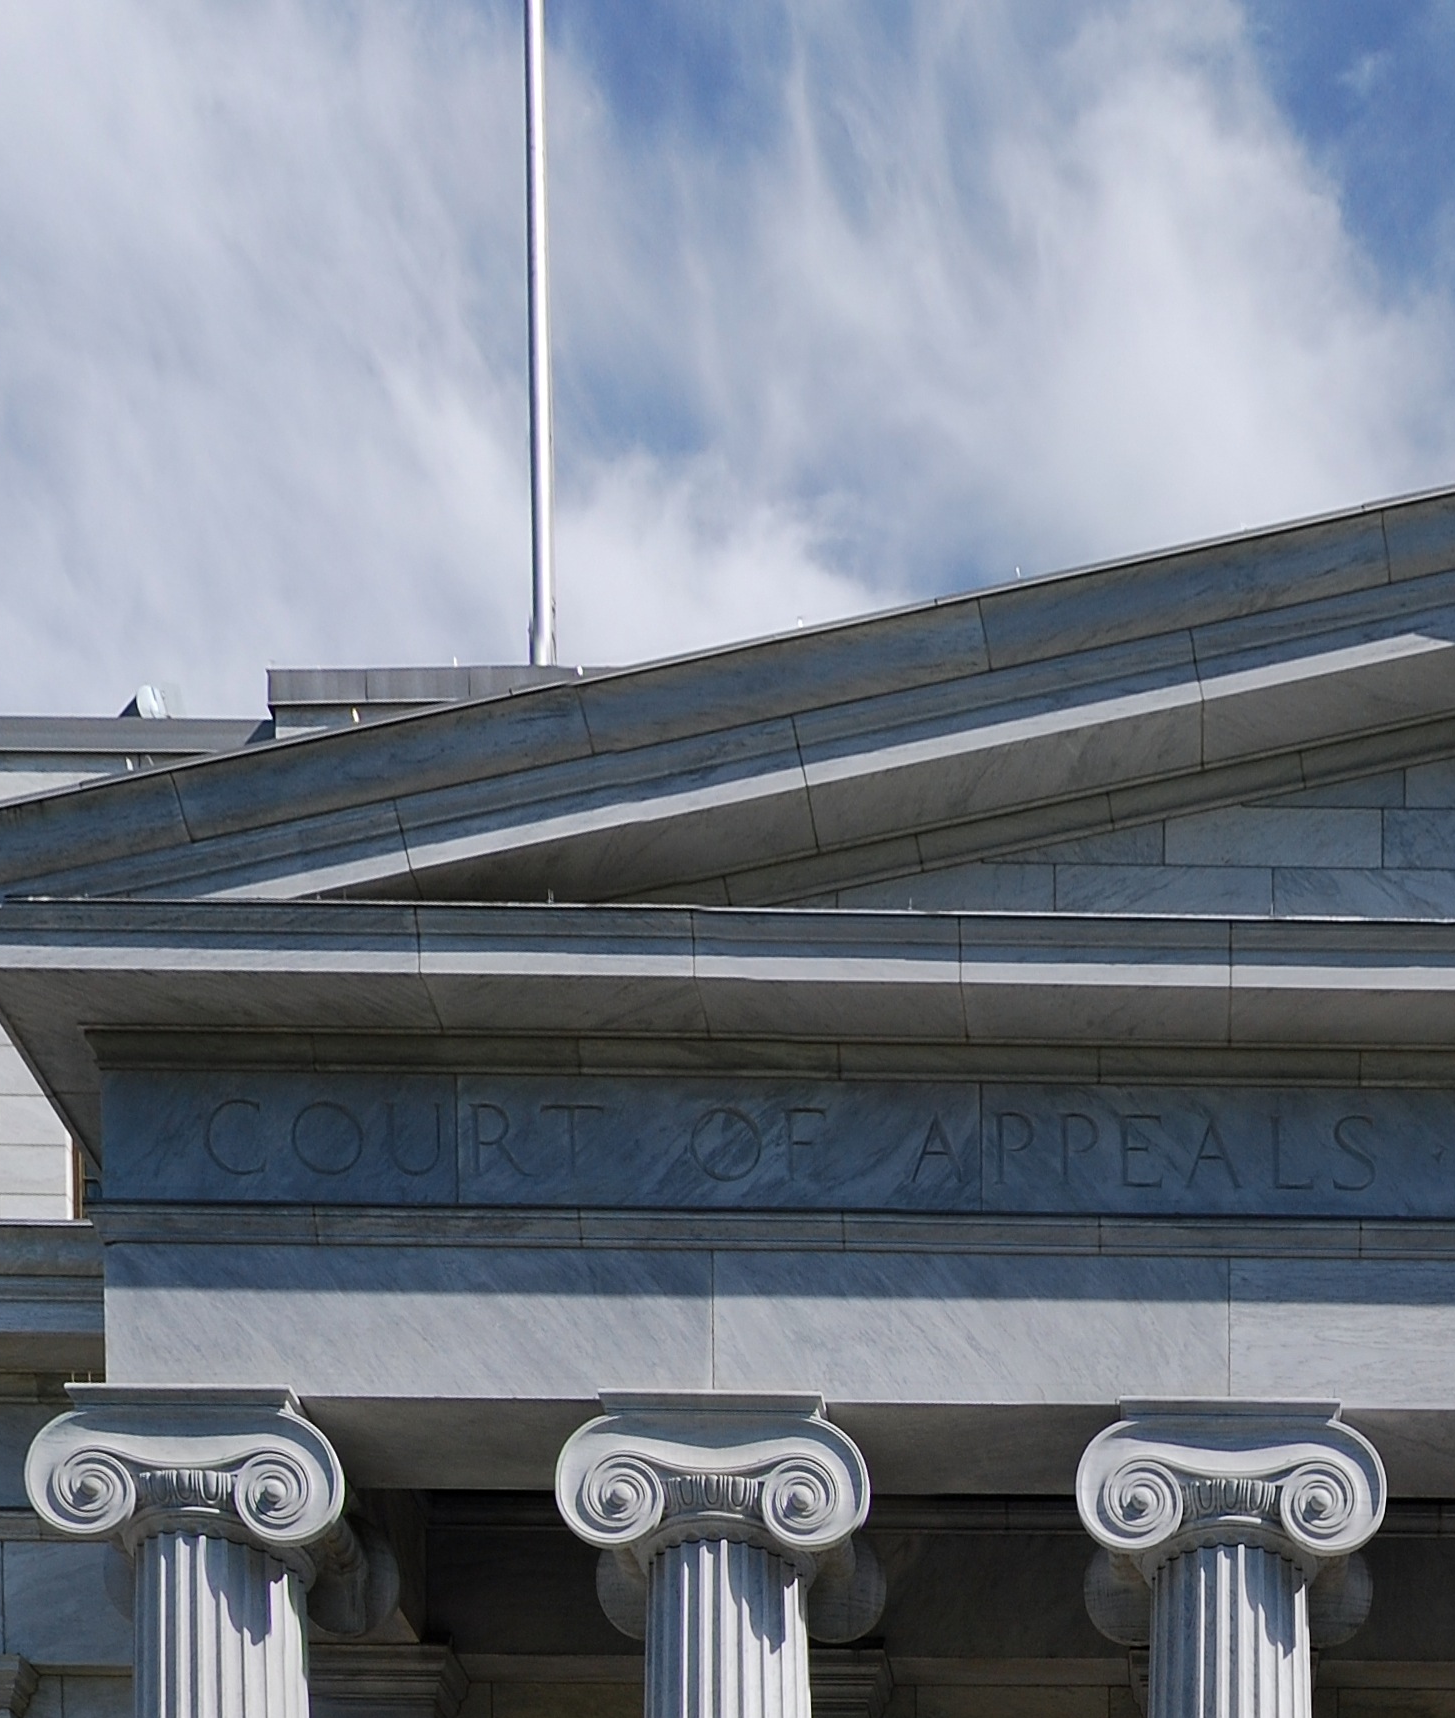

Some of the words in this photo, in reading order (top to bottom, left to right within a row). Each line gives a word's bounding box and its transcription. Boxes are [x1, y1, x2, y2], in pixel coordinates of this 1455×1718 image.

[202, 1100, 605, 1178] COURT
[690, 1106, 827, 1181] OF
[910, 1111, 1377, 1191] APPEALS
